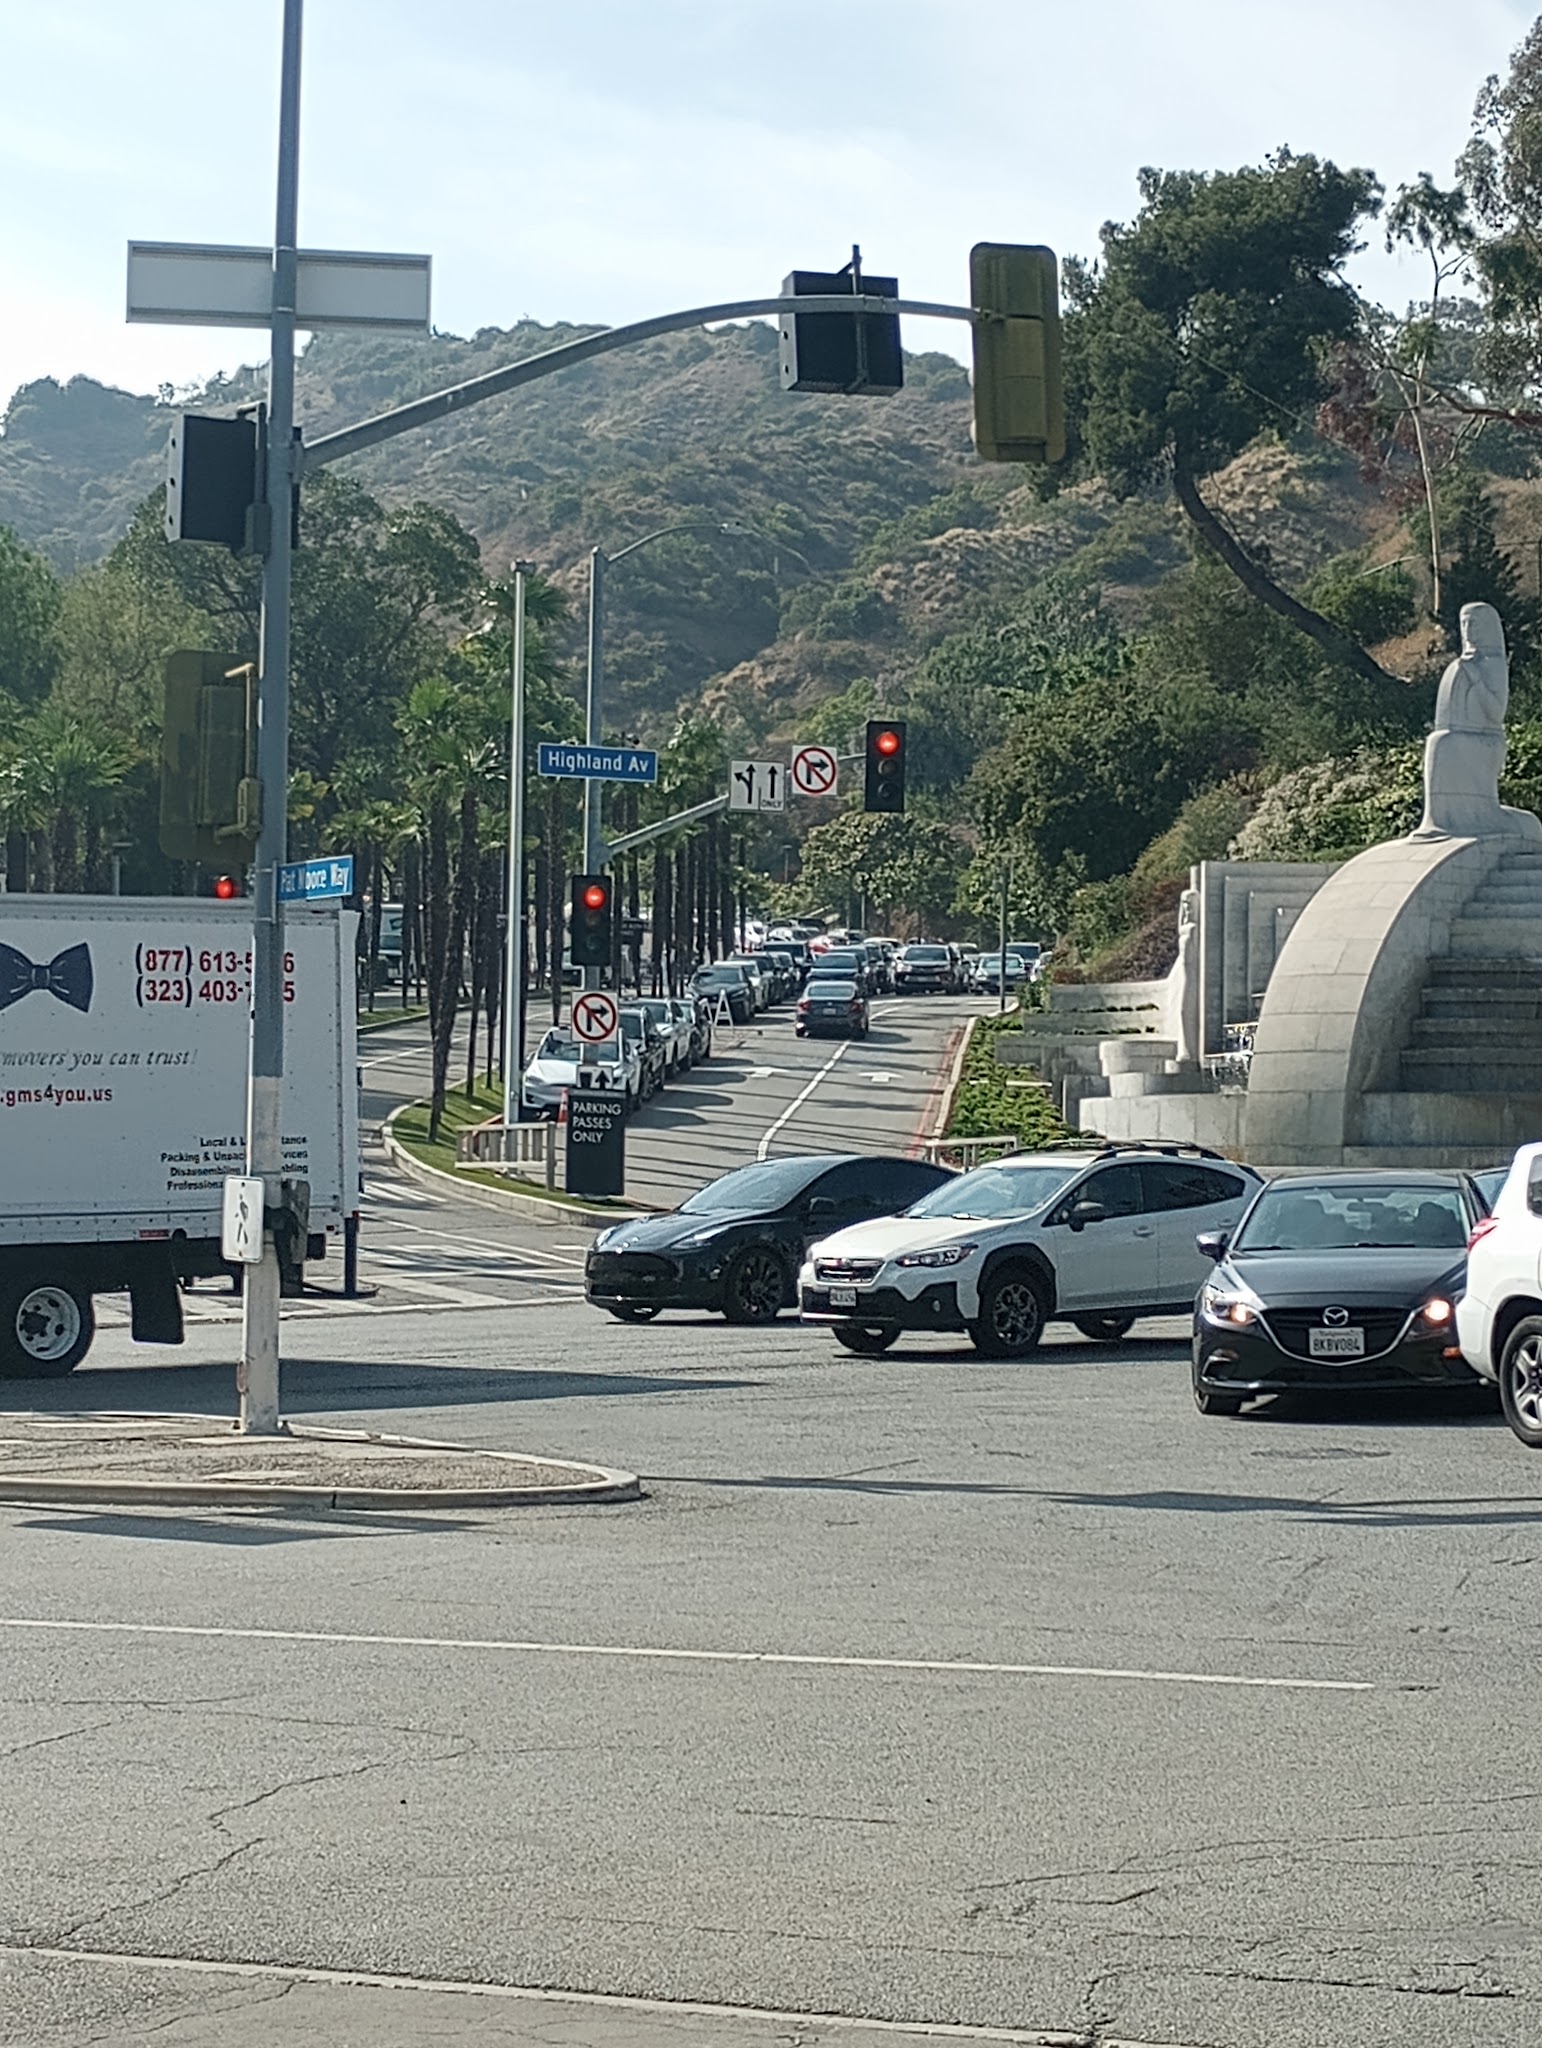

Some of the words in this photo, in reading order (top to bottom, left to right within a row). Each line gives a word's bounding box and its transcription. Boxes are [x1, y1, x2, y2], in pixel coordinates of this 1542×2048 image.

[548, 751, 622, 773] Highland
[628, 756, 649, 773] Av
[761, 799, 782, 808] ONLY
[330, 863, 349, 894] Way
[135, 943, 192, 975] (877)
[199, 950, 295, 973] 613-56
[136, 976, 192, 1008] (323)
[67, 1052, 104, 1072] you
[109, 1051, 141, 1066] can
[146, 1049, 199, 1066] trust!
[572, 1101, 621, 1116] PARKING
[572, 1116, 612, 1130] PASSES
[200, 1136, 228, 1147] Local
[230, 1136, 238, 1146] &
[572, 1130, 603, 1144] ONLY
[160, 1152, 200, 1164] Packing
[202, 1150, 210, 1161] &
